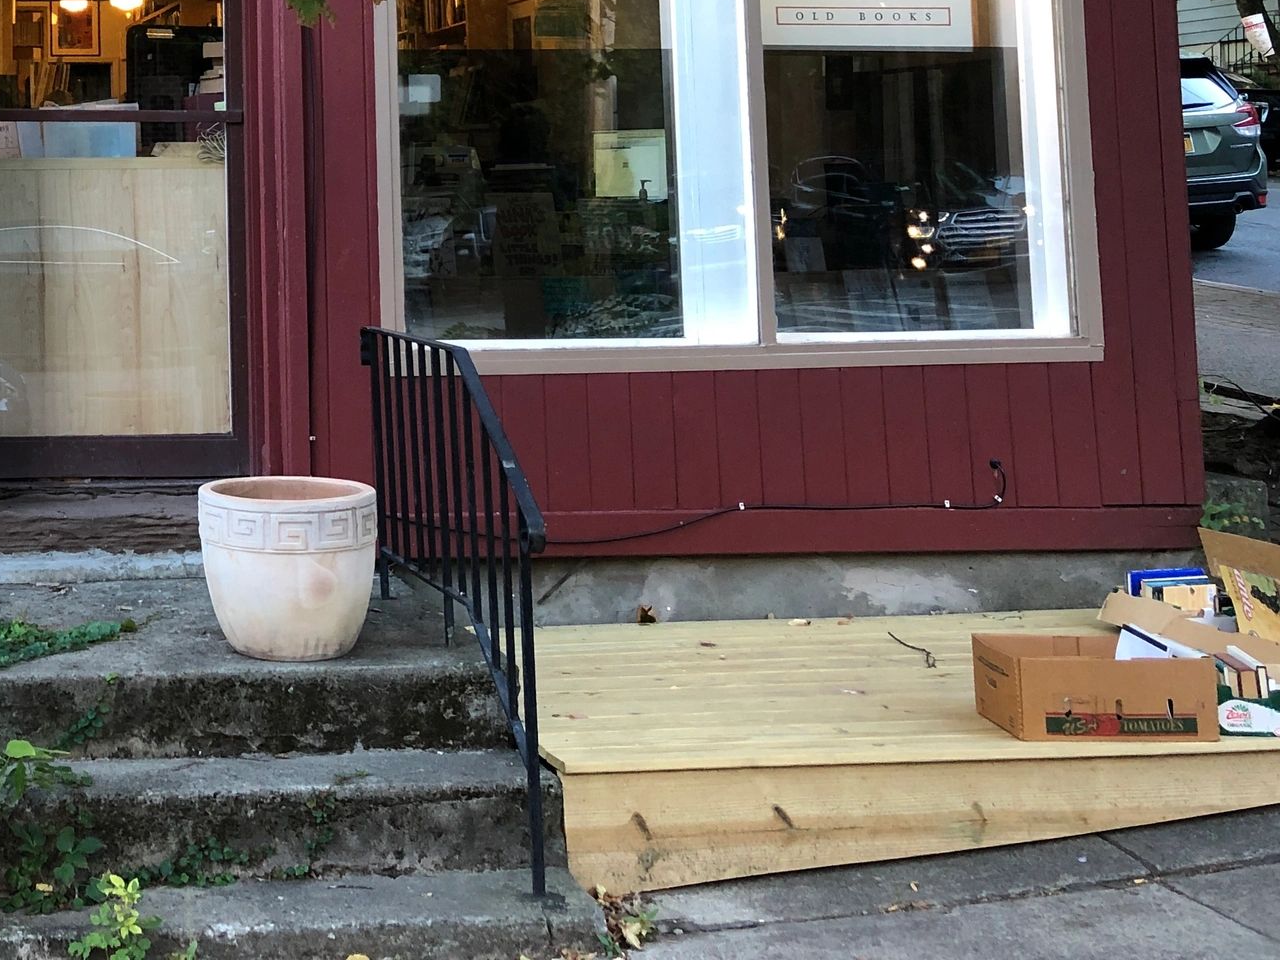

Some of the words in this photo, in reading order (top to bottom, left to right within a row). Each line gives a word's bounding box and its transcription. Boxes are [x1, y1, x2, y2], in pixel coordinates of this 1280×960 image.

[795, 11, 835, 21] OLD
[859, 12, 933, 22] BOOKS
[1123, 720, 1185, 732] TOMATOES
